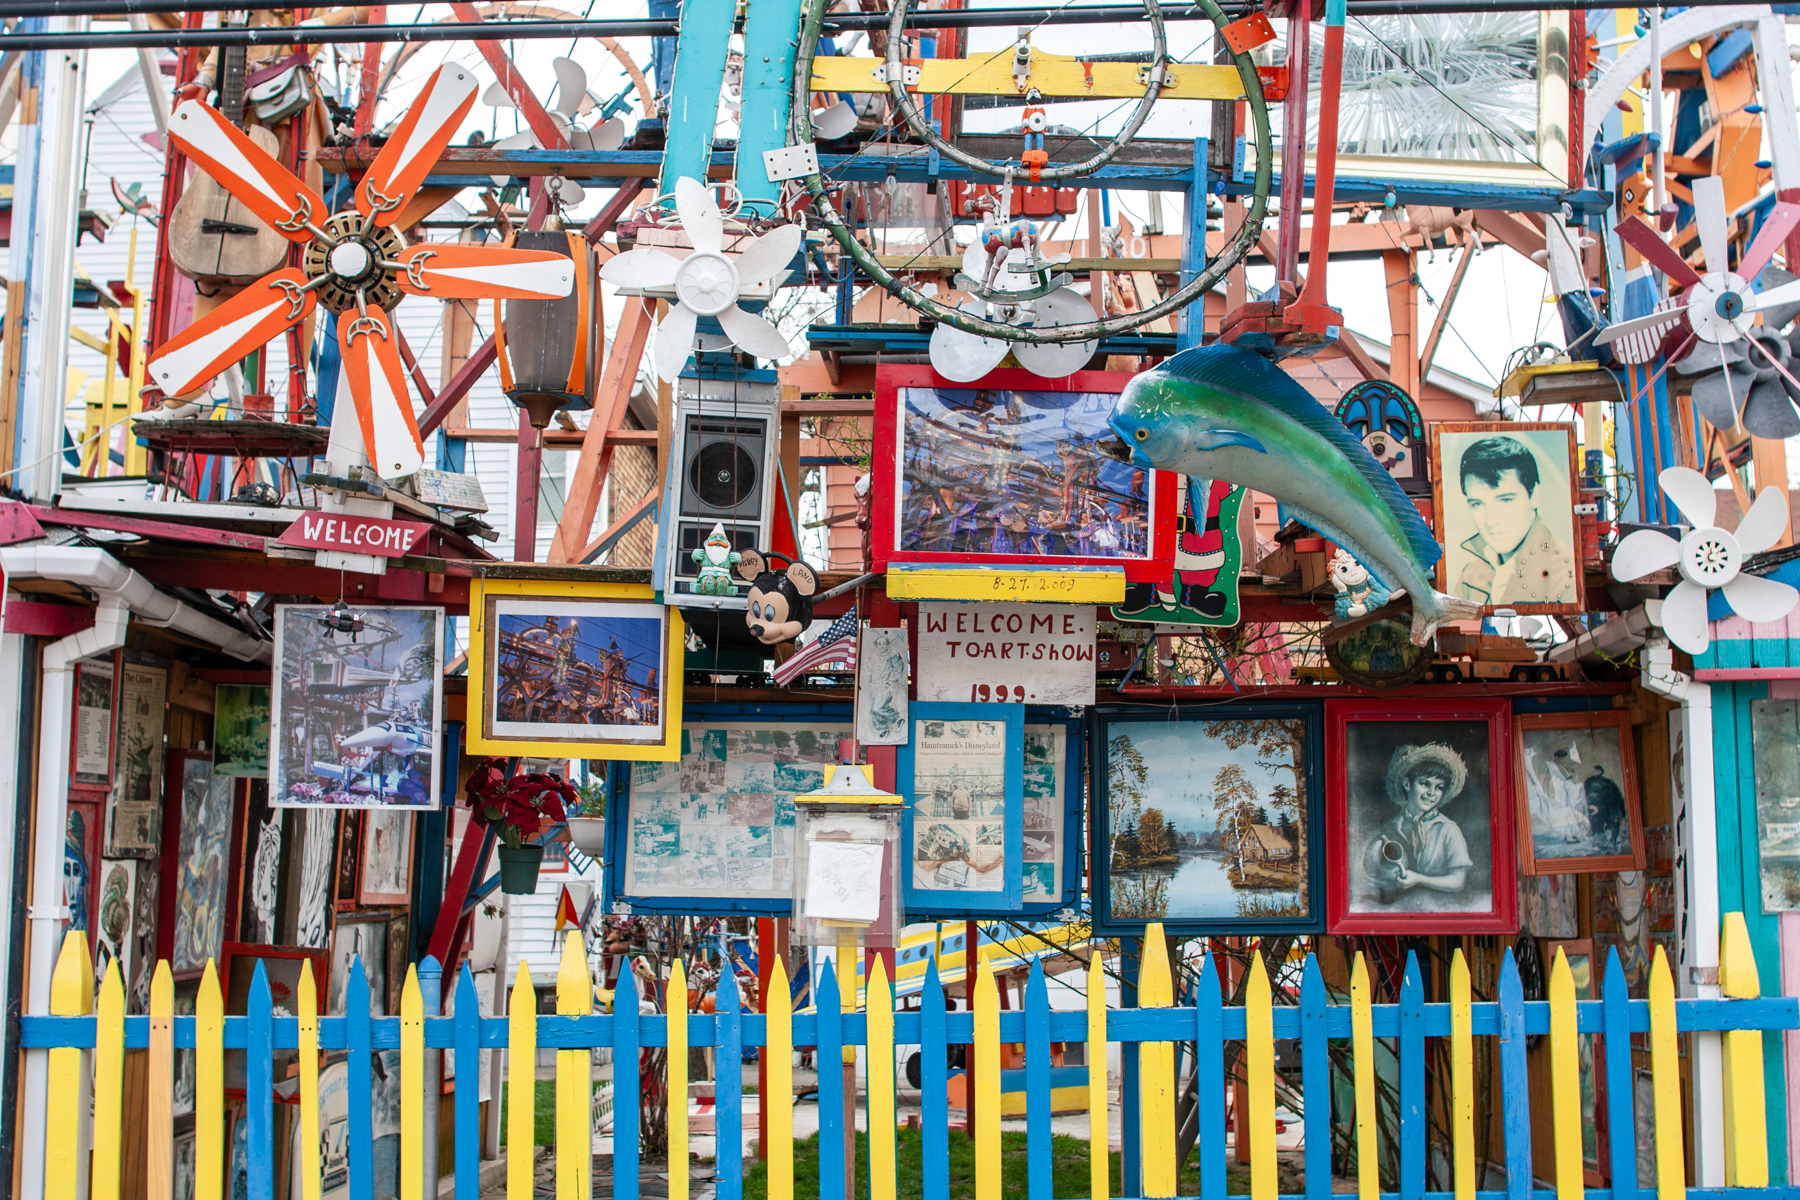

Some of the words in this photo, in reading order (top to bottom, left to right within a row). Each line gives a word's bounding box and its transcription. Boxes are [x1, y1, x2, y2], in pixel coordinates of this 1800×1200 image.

[304, 516, 415, 550] WELCOME
[792, 567, 813, 584] LAND
[921, 741, 963, 749] Hamtramck's
[965, 741, 1001, 750] Disneyland
